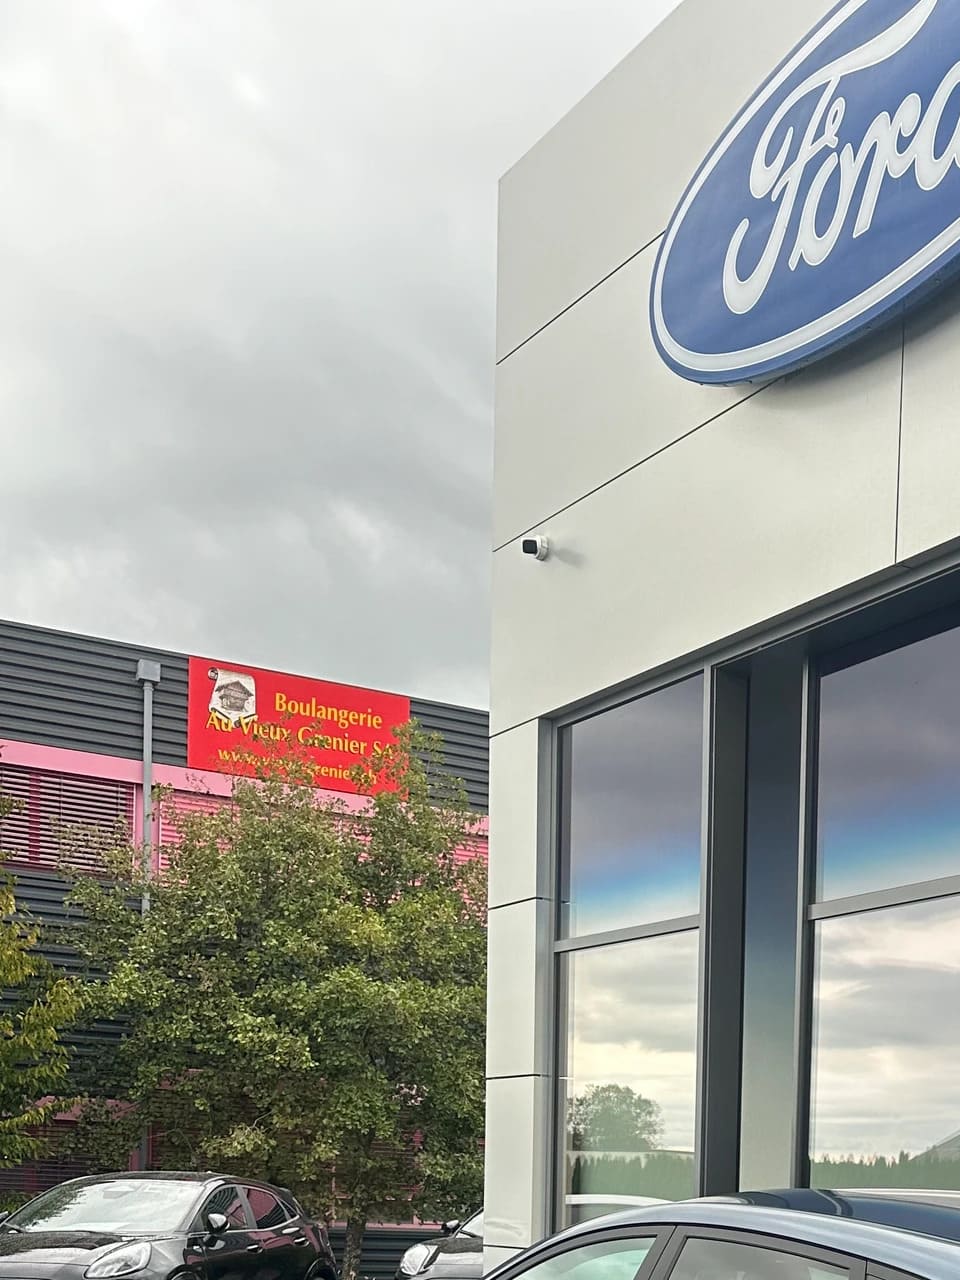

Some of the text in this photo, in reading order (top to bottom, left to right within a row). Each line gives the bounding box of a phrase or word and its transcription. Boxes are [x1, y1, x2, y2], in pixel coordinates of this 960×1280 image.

[205, 711, 233, 733] Au
[239, 714, 291, 741] Vieux
[275, 692, 383, 729] Boulangerie
